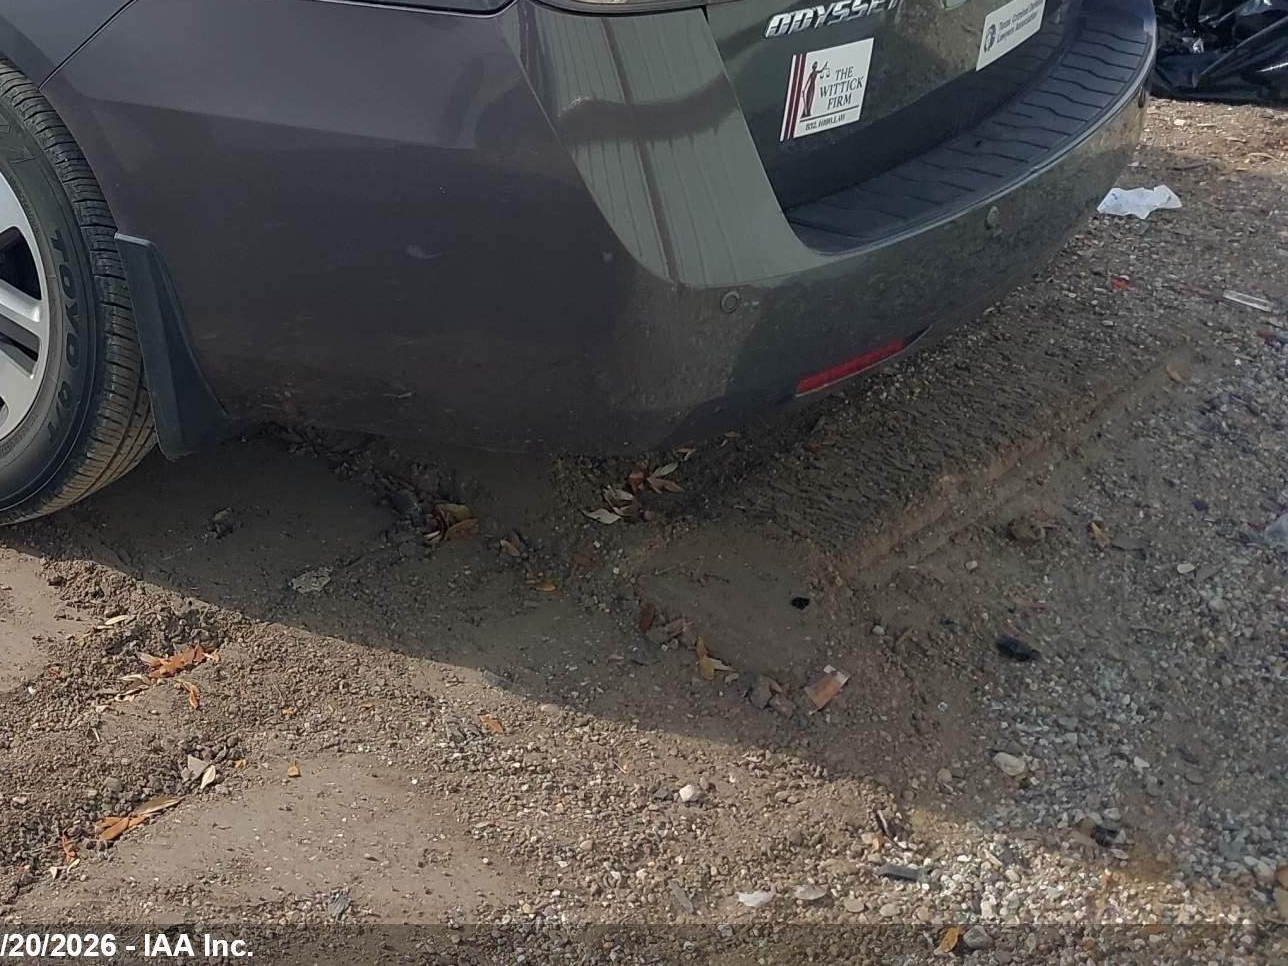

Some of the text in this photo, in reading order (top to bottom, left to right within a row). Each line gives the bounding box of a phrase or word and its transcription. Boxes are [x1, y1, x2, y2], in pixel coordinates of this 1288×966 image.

[835, 66, 854, 81] THE
[819, 75, 864, 98] WITTICK
[827, 93, 852, 110] FIRM
[50, 228, 82, 370] TOYO
